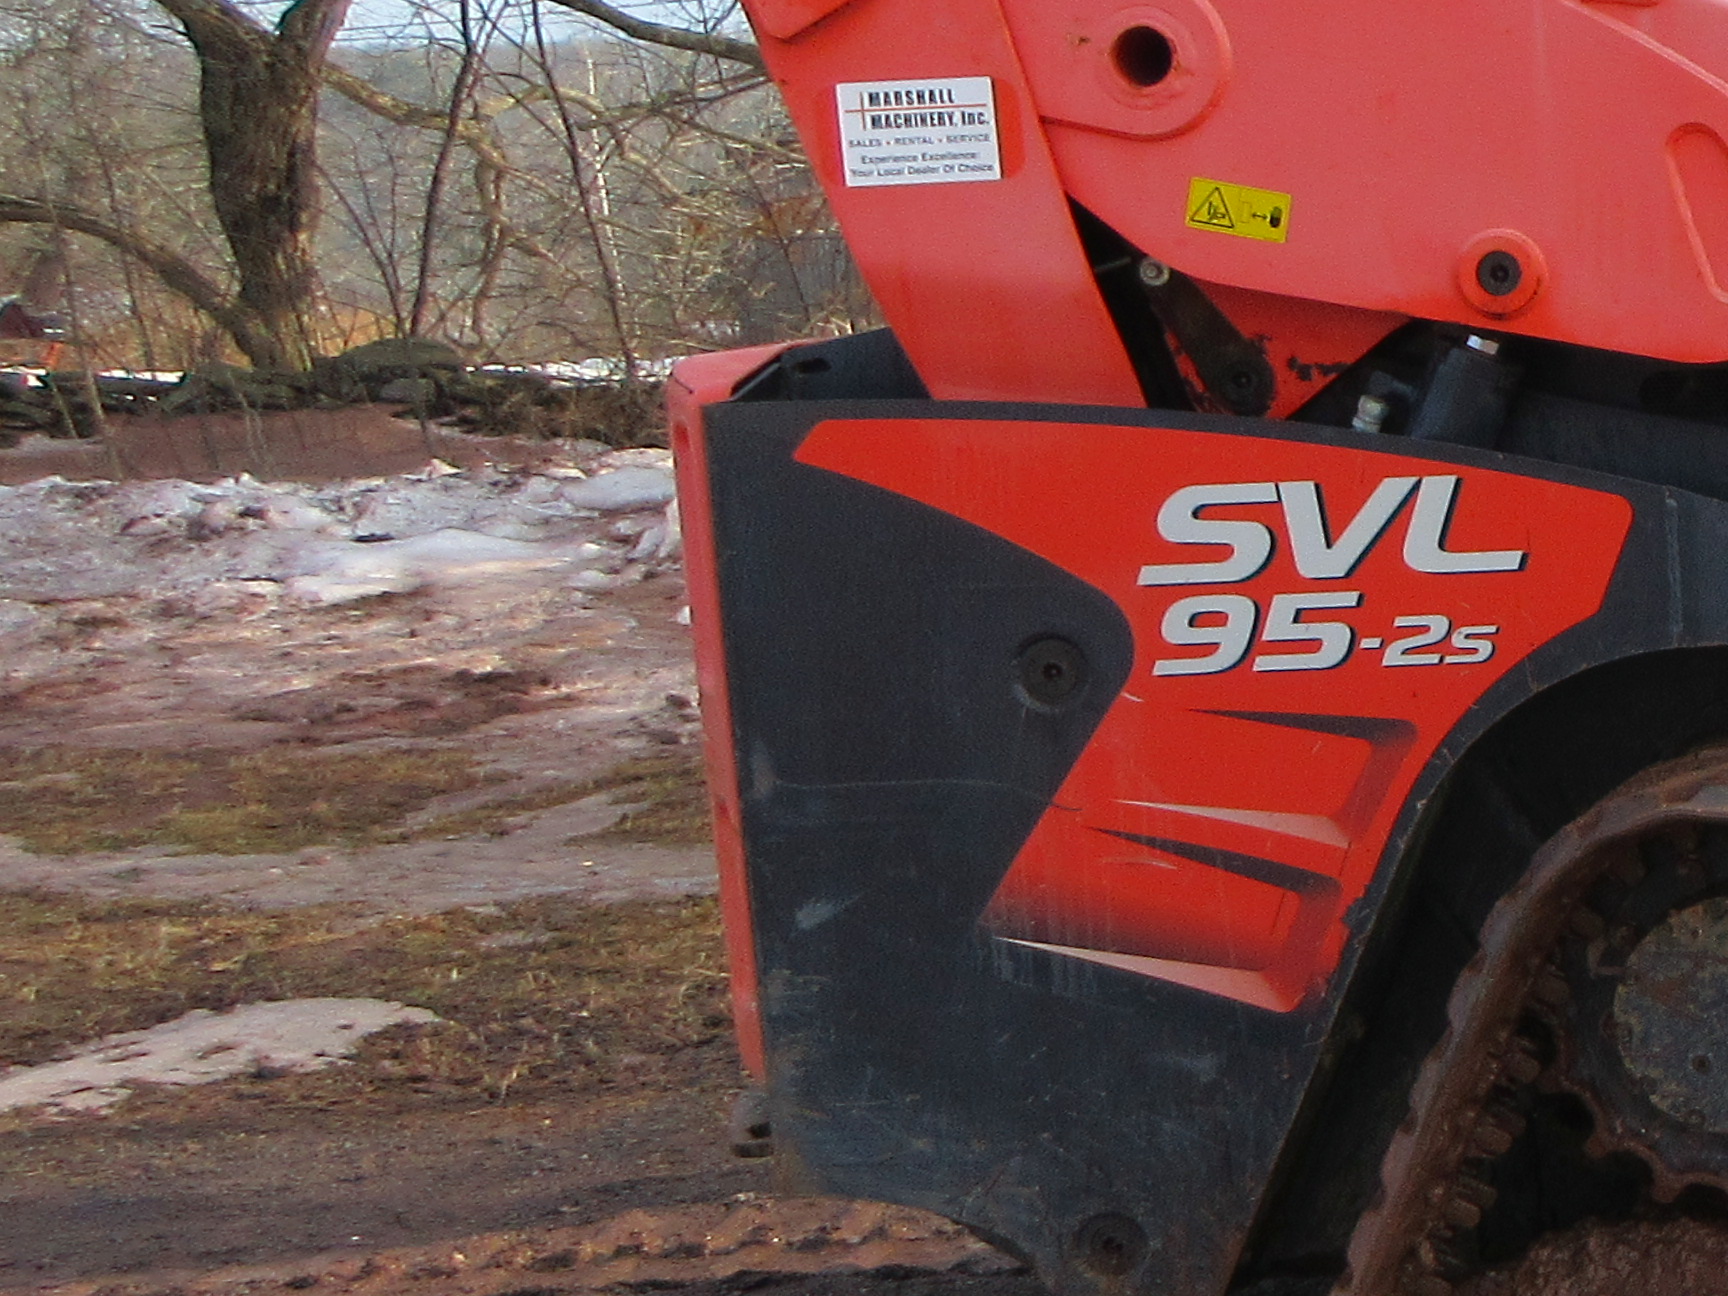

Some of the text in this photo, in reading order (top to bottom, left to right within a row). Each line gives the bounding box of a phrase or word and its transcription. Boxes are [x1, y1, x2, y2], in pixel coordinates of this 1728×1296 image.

[868, 89, 955, 107] MARSHALL
[961, 110, 990, 126] Inc.
[1136, 474, 1524, 586] SVL
